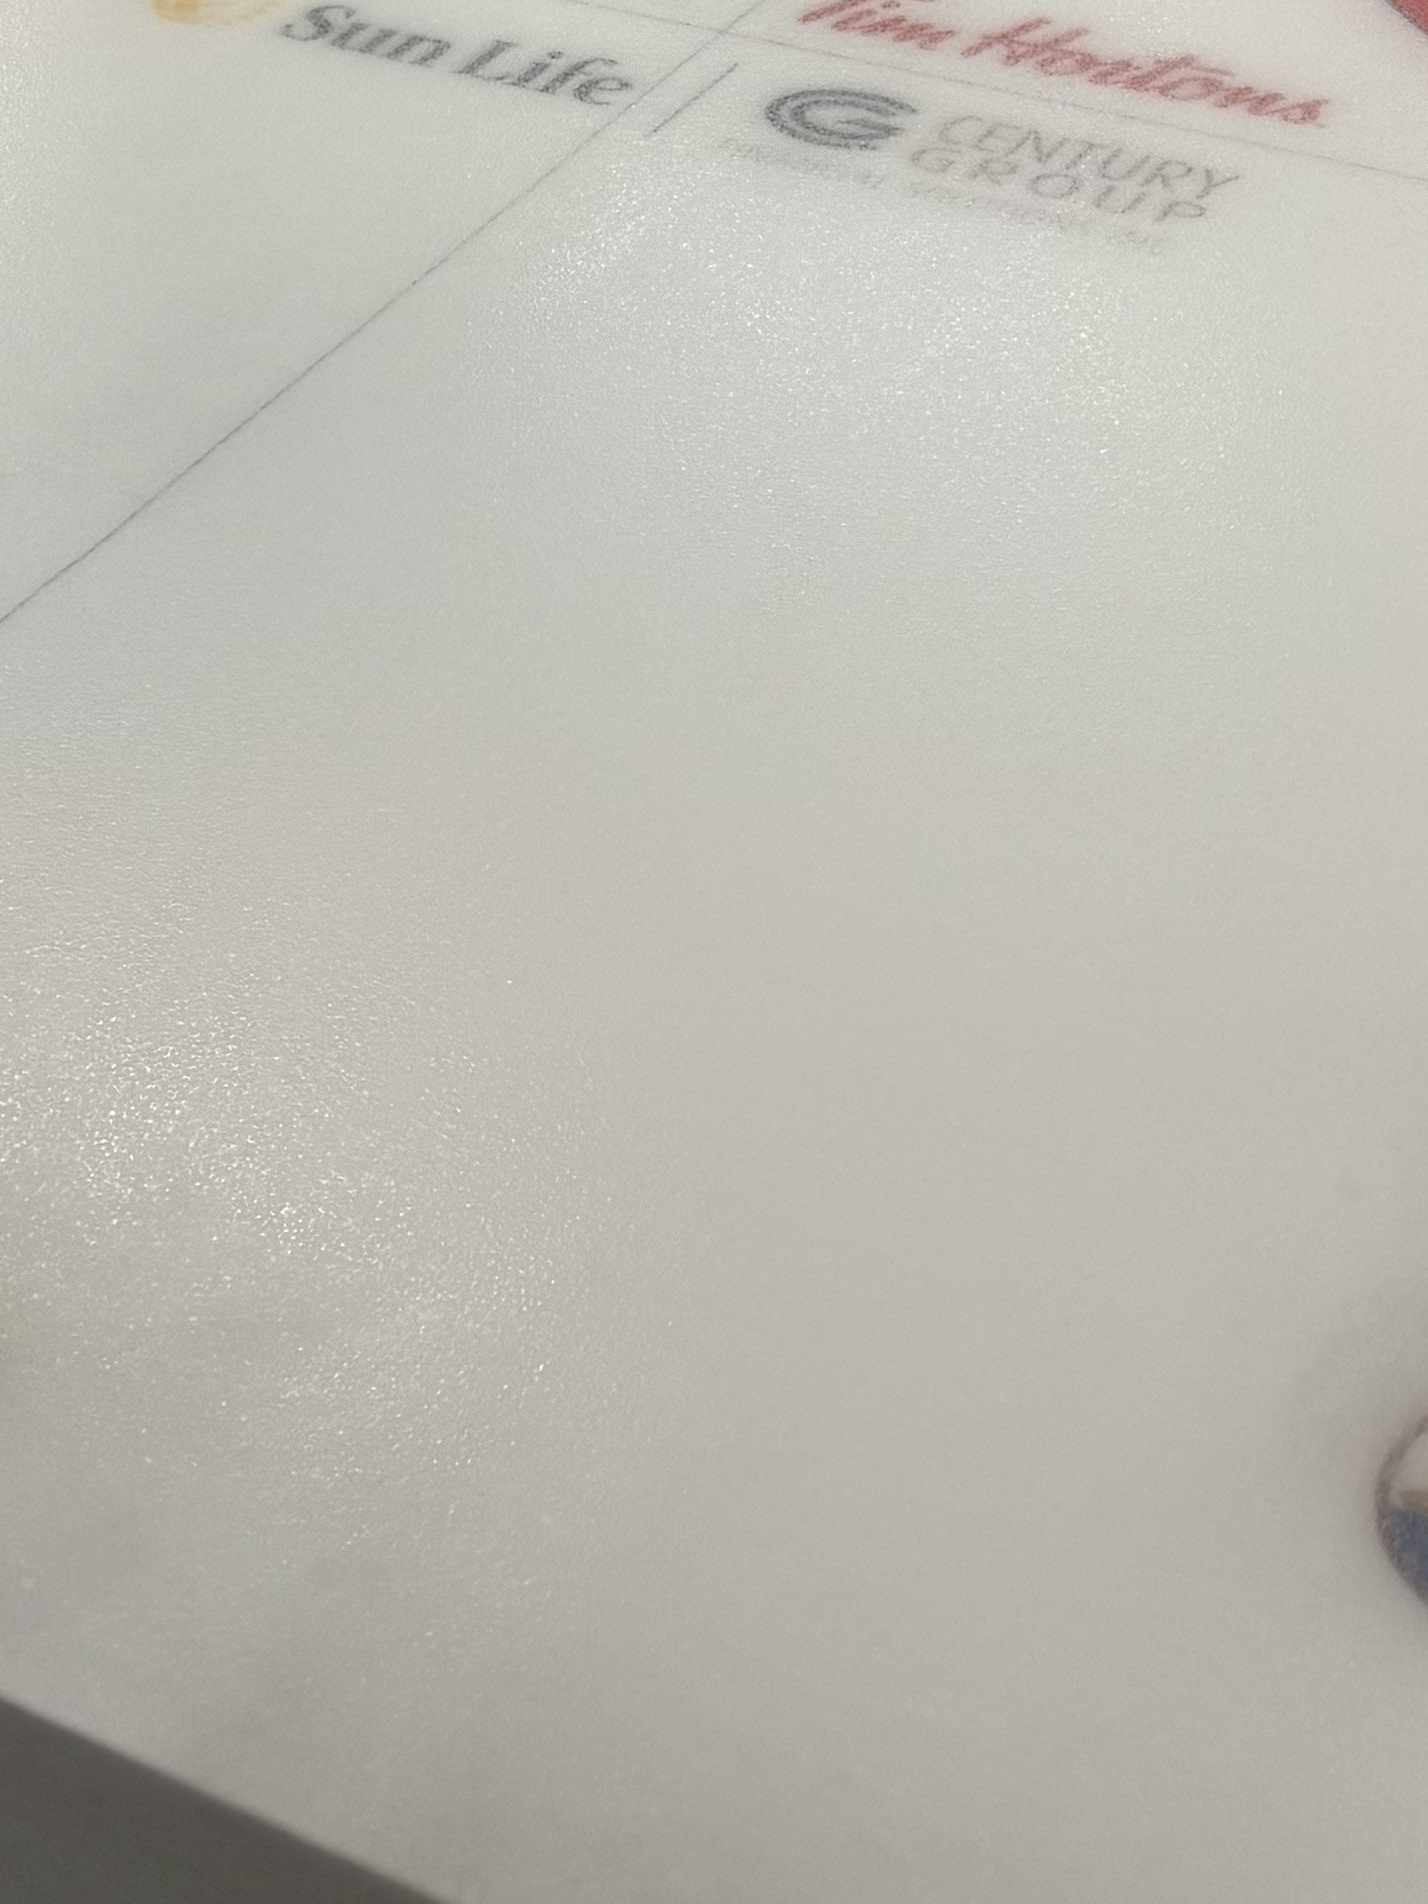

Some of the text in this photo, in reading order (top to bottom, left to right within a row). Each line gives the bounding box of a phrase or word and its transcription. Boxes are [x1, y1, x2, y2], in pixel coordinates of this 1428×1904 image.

[279, 3, 634, 106] Sun Life
[960, 15, 1332, 128] Hortons
[910, 145, 1210, 223] GROUP
[937, 114, 1241, 200] CENTURY
